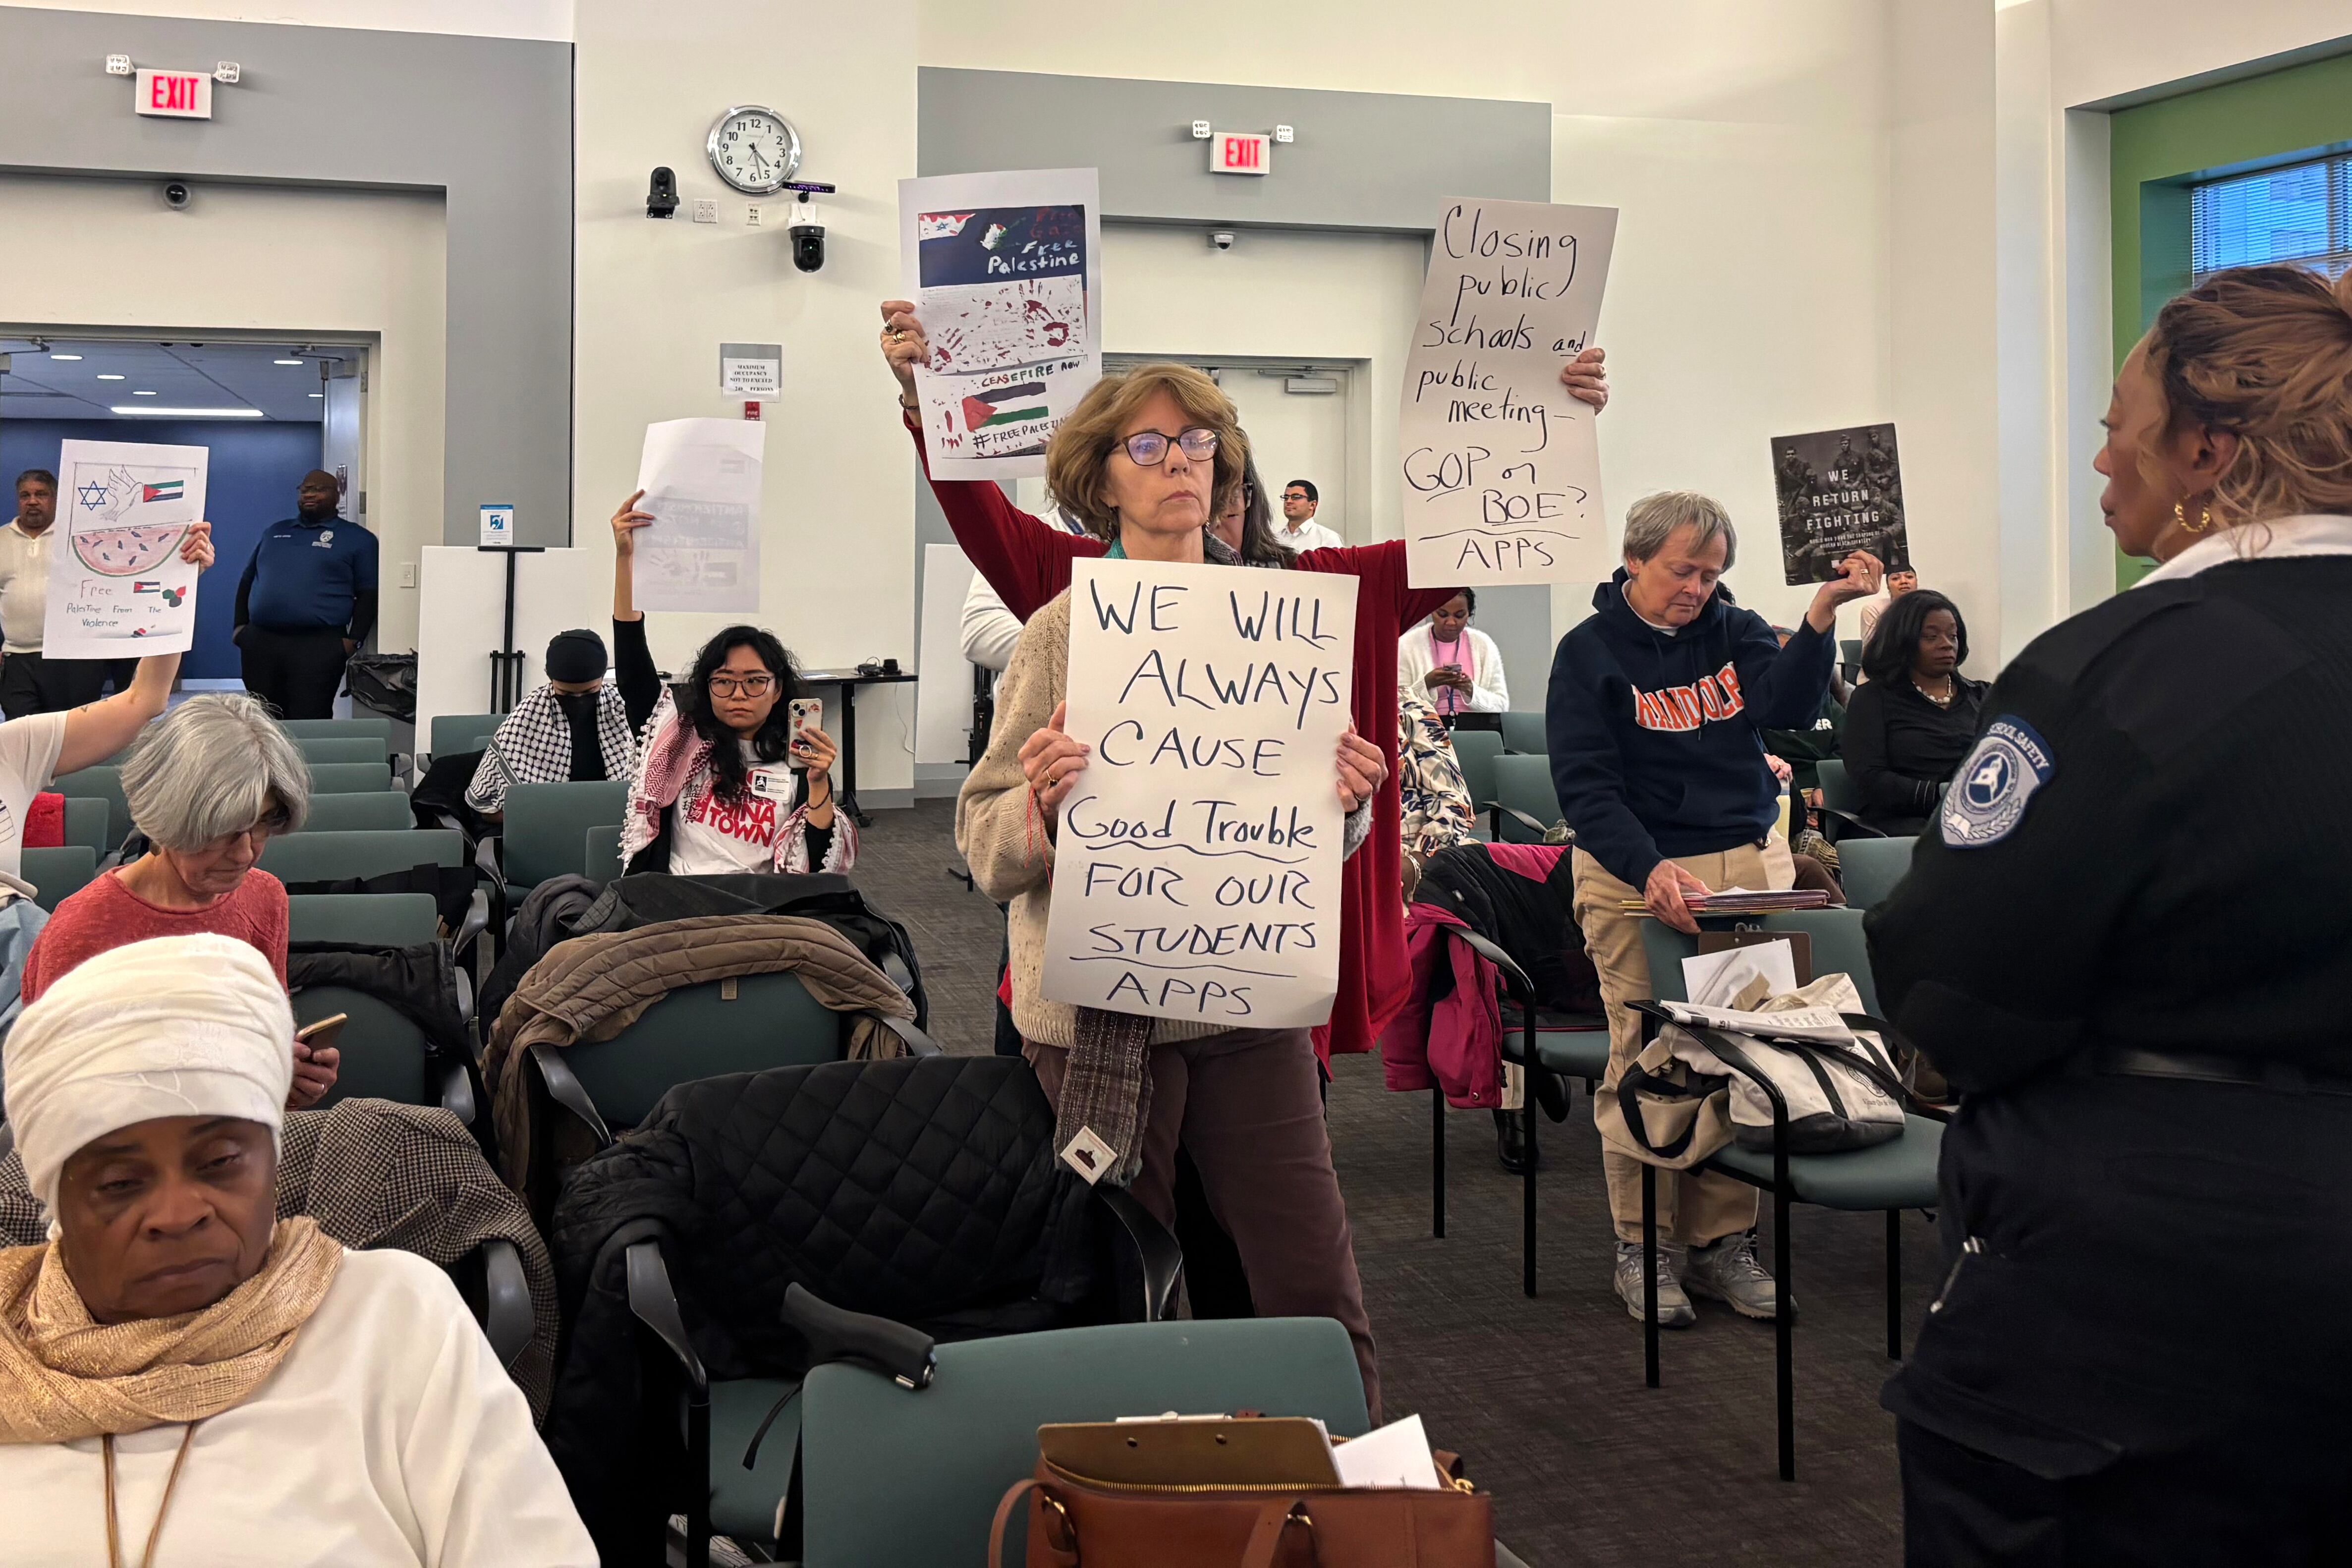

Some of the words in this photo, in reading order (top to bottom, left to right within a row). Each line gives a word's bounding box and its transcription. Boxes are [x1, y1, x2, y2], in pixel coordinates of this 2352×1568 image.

[152, 75, 199, 111] EXIT
[736, 122, 746, 131] 11
[750, 118, 761, 128] 12
[767, 125, 772, 134] 1
[727, 132, 738, 141] 10
[776, 136, 783, 145] 2
[722, 143, 729, 153] 9
[779, 148, 786, 158] 3
[1226, 137, 1261, 168] EXIT
[726, 156, 733, 165] 8
[774, 160, 781, 169] 4
[736, 168, 743, 177] 7
[750, 173, 756, 182] 6
[764, 170, 770, 179] 5
[1021, 239, 1079, 257] Free
[1444, 205, 1577, 297] Closing
[987, 252, 1080, 274] Palestine
[1450, 265, 1549, 327] public
[1552, 331, 1586, 353] and
[981, 364, 1054, 387] CEASEFIRE
[1416, 359, 1499, 402] public
[1403, 446, 1491, 491] GOP
[1501, 462, 1536, 485] or
[1828, 469, 1848, 482] WE
[1482, 485, 1588, 524] BOE?
[1812, 489, 1869, 507] RETURN
[1806, 511, 1880, 530] FIGHTING
[1456, 537, 1555, 571] APPS
[81, 579, 112, 599] Free
[82, 618, 118, 627] Violence
[1090, 578, 1188, 635] WE
[1230, 590, 1338, 650] WILL
[1118, 649, 1340, 730] ALWAYS
[1099, 720, 1286, 777] CAUSE
[709, 806, 775, 847] TOWN
[1067, 795, 1176, 839] Good
[1192, 800, 1317, 849] Trouble
[1084, 861, 1189, 907] FOR
[1215, 870, 1316, 910] OUR
[1088, 921, 1316, 955] STUDENTS
[1106, 971, 1252, 1015] APPS
